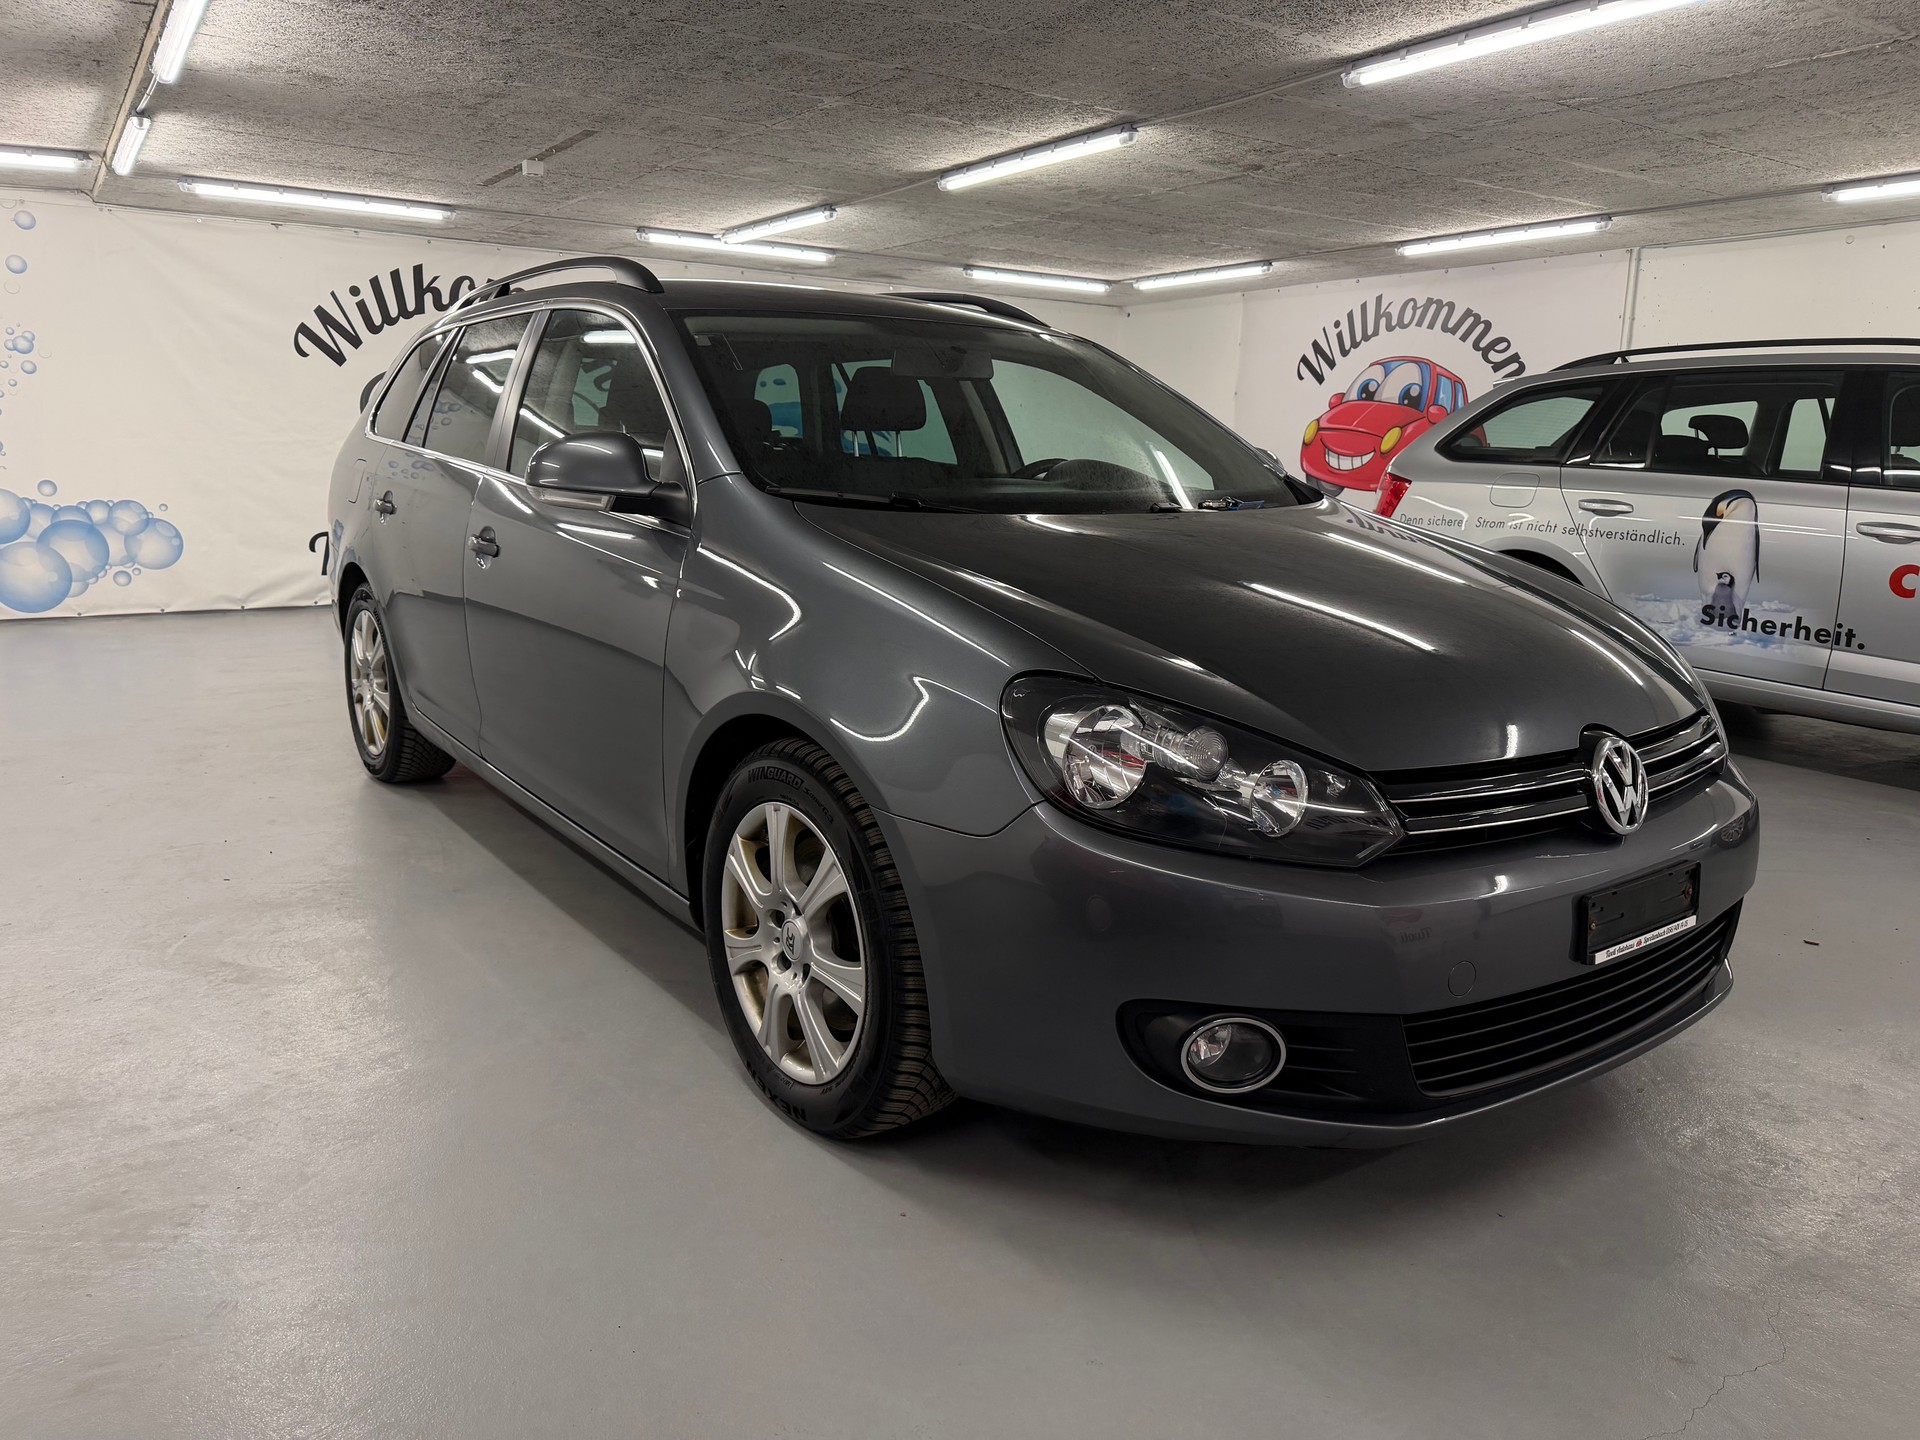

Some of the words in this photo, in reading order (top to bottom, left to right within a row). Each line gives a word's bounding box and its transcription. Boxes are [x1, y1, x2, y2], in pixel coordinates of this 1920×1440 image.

[293, 263, 497, 367] Willko
[1297, 294, 1527, 386] Willkommen
[1399, 513, 1424, 526] Denn
[1427, 514, 1466, 528] sichere
[1475, 517, 1506, 530] Strom
[1526, 519, 1558, 534] nicht
[1561, 523, 1686, 547] selbstverständlich.
[1700, 604, 1866, 650] Sicherheit.
[748, 766, 804, 790] WINGUARD
[1597, 739, 1645, 833] VW
